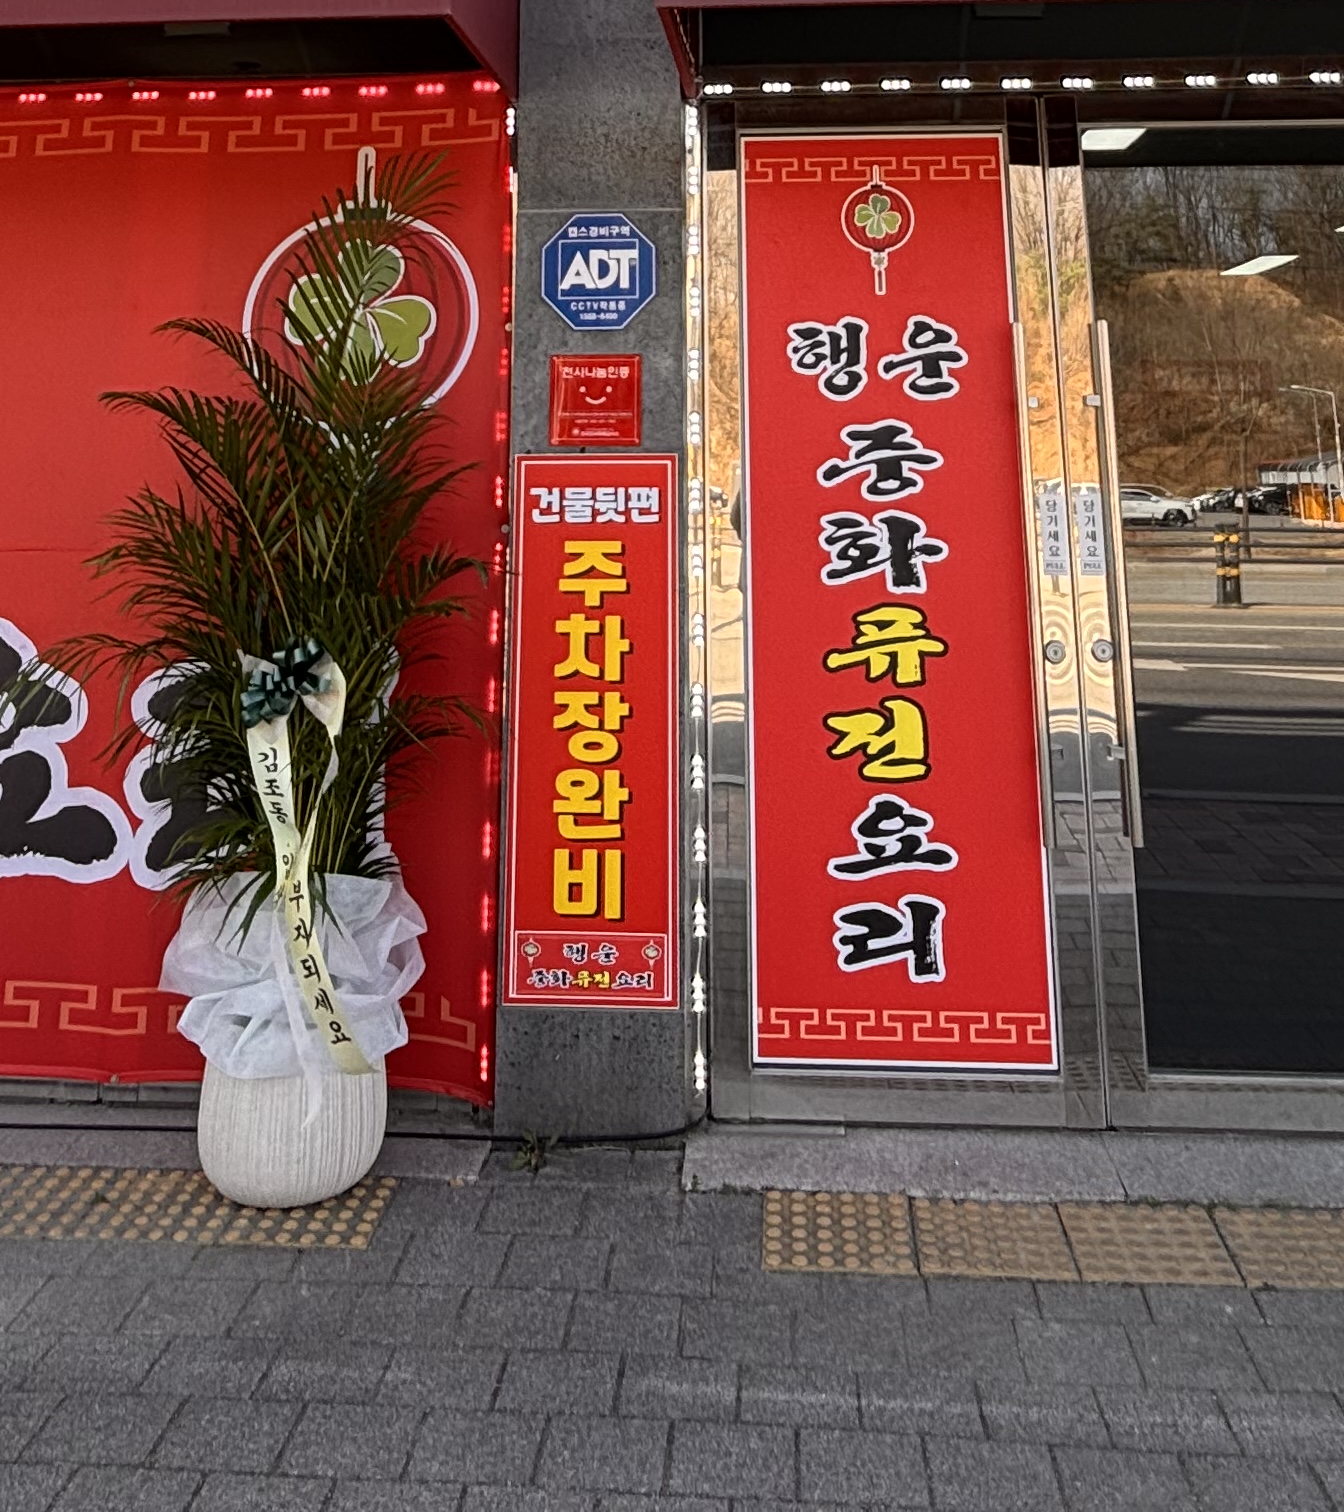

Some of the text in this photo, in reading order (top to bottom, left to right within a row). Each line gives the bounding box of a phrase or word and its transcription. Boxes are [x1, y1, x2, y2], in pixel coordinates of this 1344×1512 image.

[560, 248, 638, 290] ADT
[787, 314, 969, 402] 행운
[528, 486, 660, 524] 건물뒷편
[1045, 499, 1061, 557] 당기세요
[1082, 499, 1100, 557] 당기세요
[551, 540, 631, 921] 주차장완비
[821, 601, 948, 781] 퓨전
[827, 791, 959, 984] 요리
[288, 880, 352, 1045] 부자되세요
